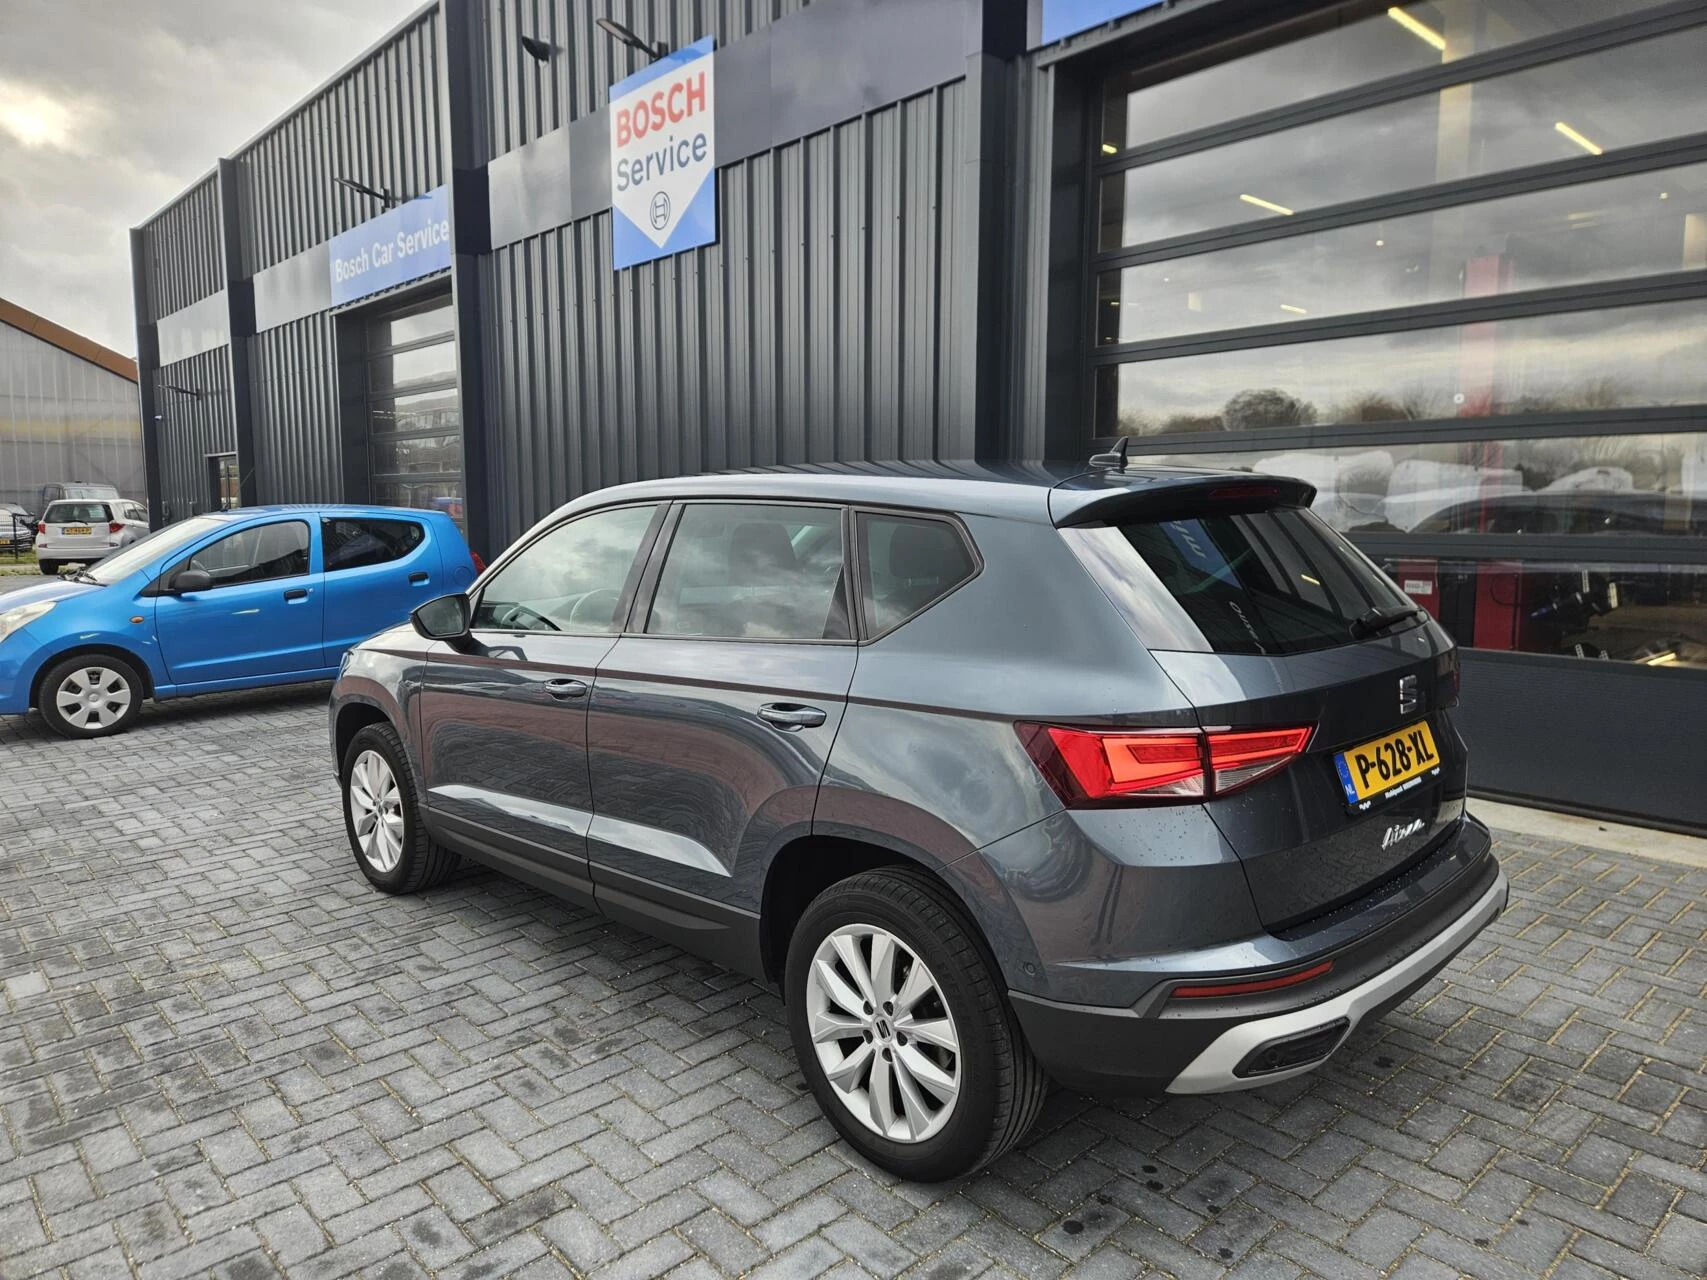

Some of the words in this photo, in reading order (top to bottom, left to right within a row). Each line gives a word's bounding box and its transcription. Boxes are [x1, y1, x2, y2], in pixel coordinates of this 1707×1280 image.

[615, 71, 707, 148] BOSCH
[616, 132, 708, 192] Service
[335, 250, 369, 283] Bosch
[372, 239, 394, 269] Car
[397, 220, 450, 259] Service
[1344, 783, 1356, 797] NL
[1355, 729, 1435, 790] P-628-XL
